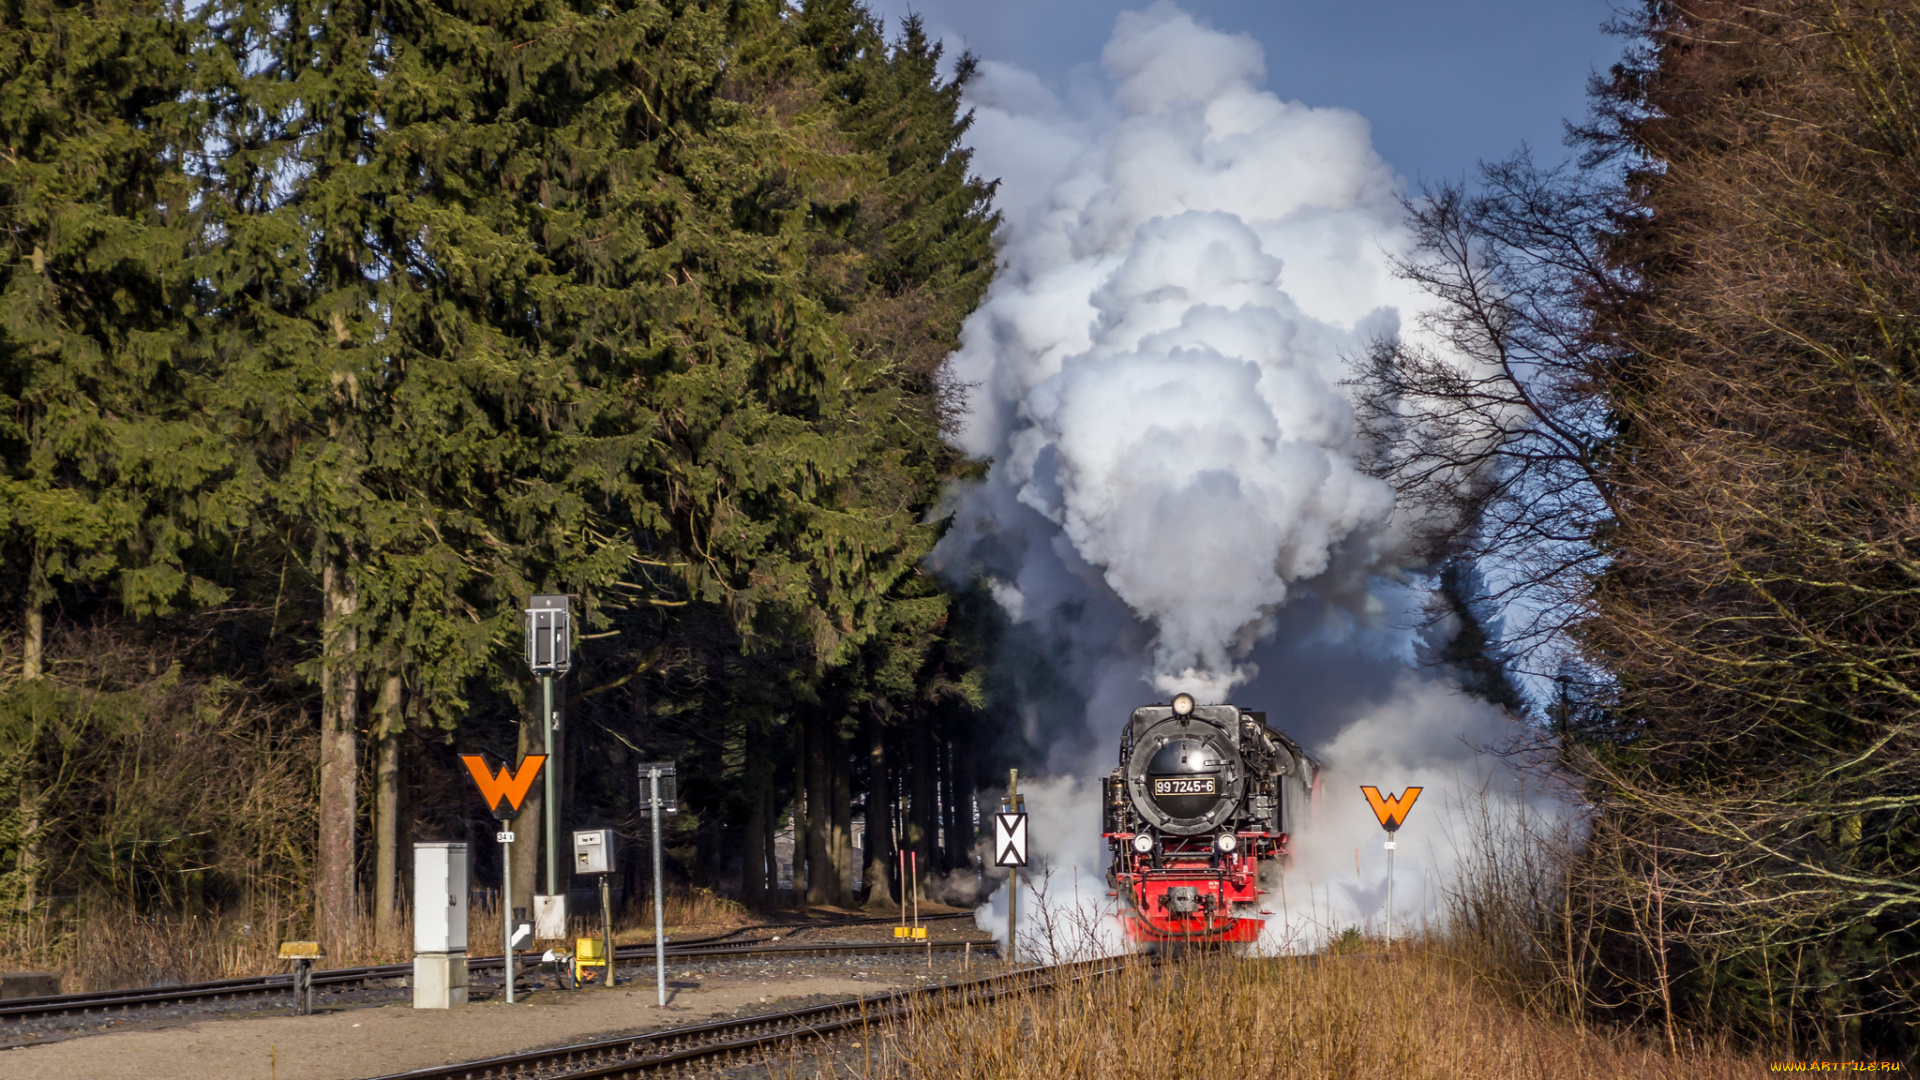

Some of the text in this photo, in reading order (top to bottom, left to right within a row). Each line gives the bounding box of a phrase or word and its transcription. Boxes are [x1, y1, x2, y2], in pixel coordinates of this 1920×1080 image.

[460, 754, 547, 812] W
[1157, 781, 1213, 793] 99 7245-6
[1360, 786, 1423, 827] W
